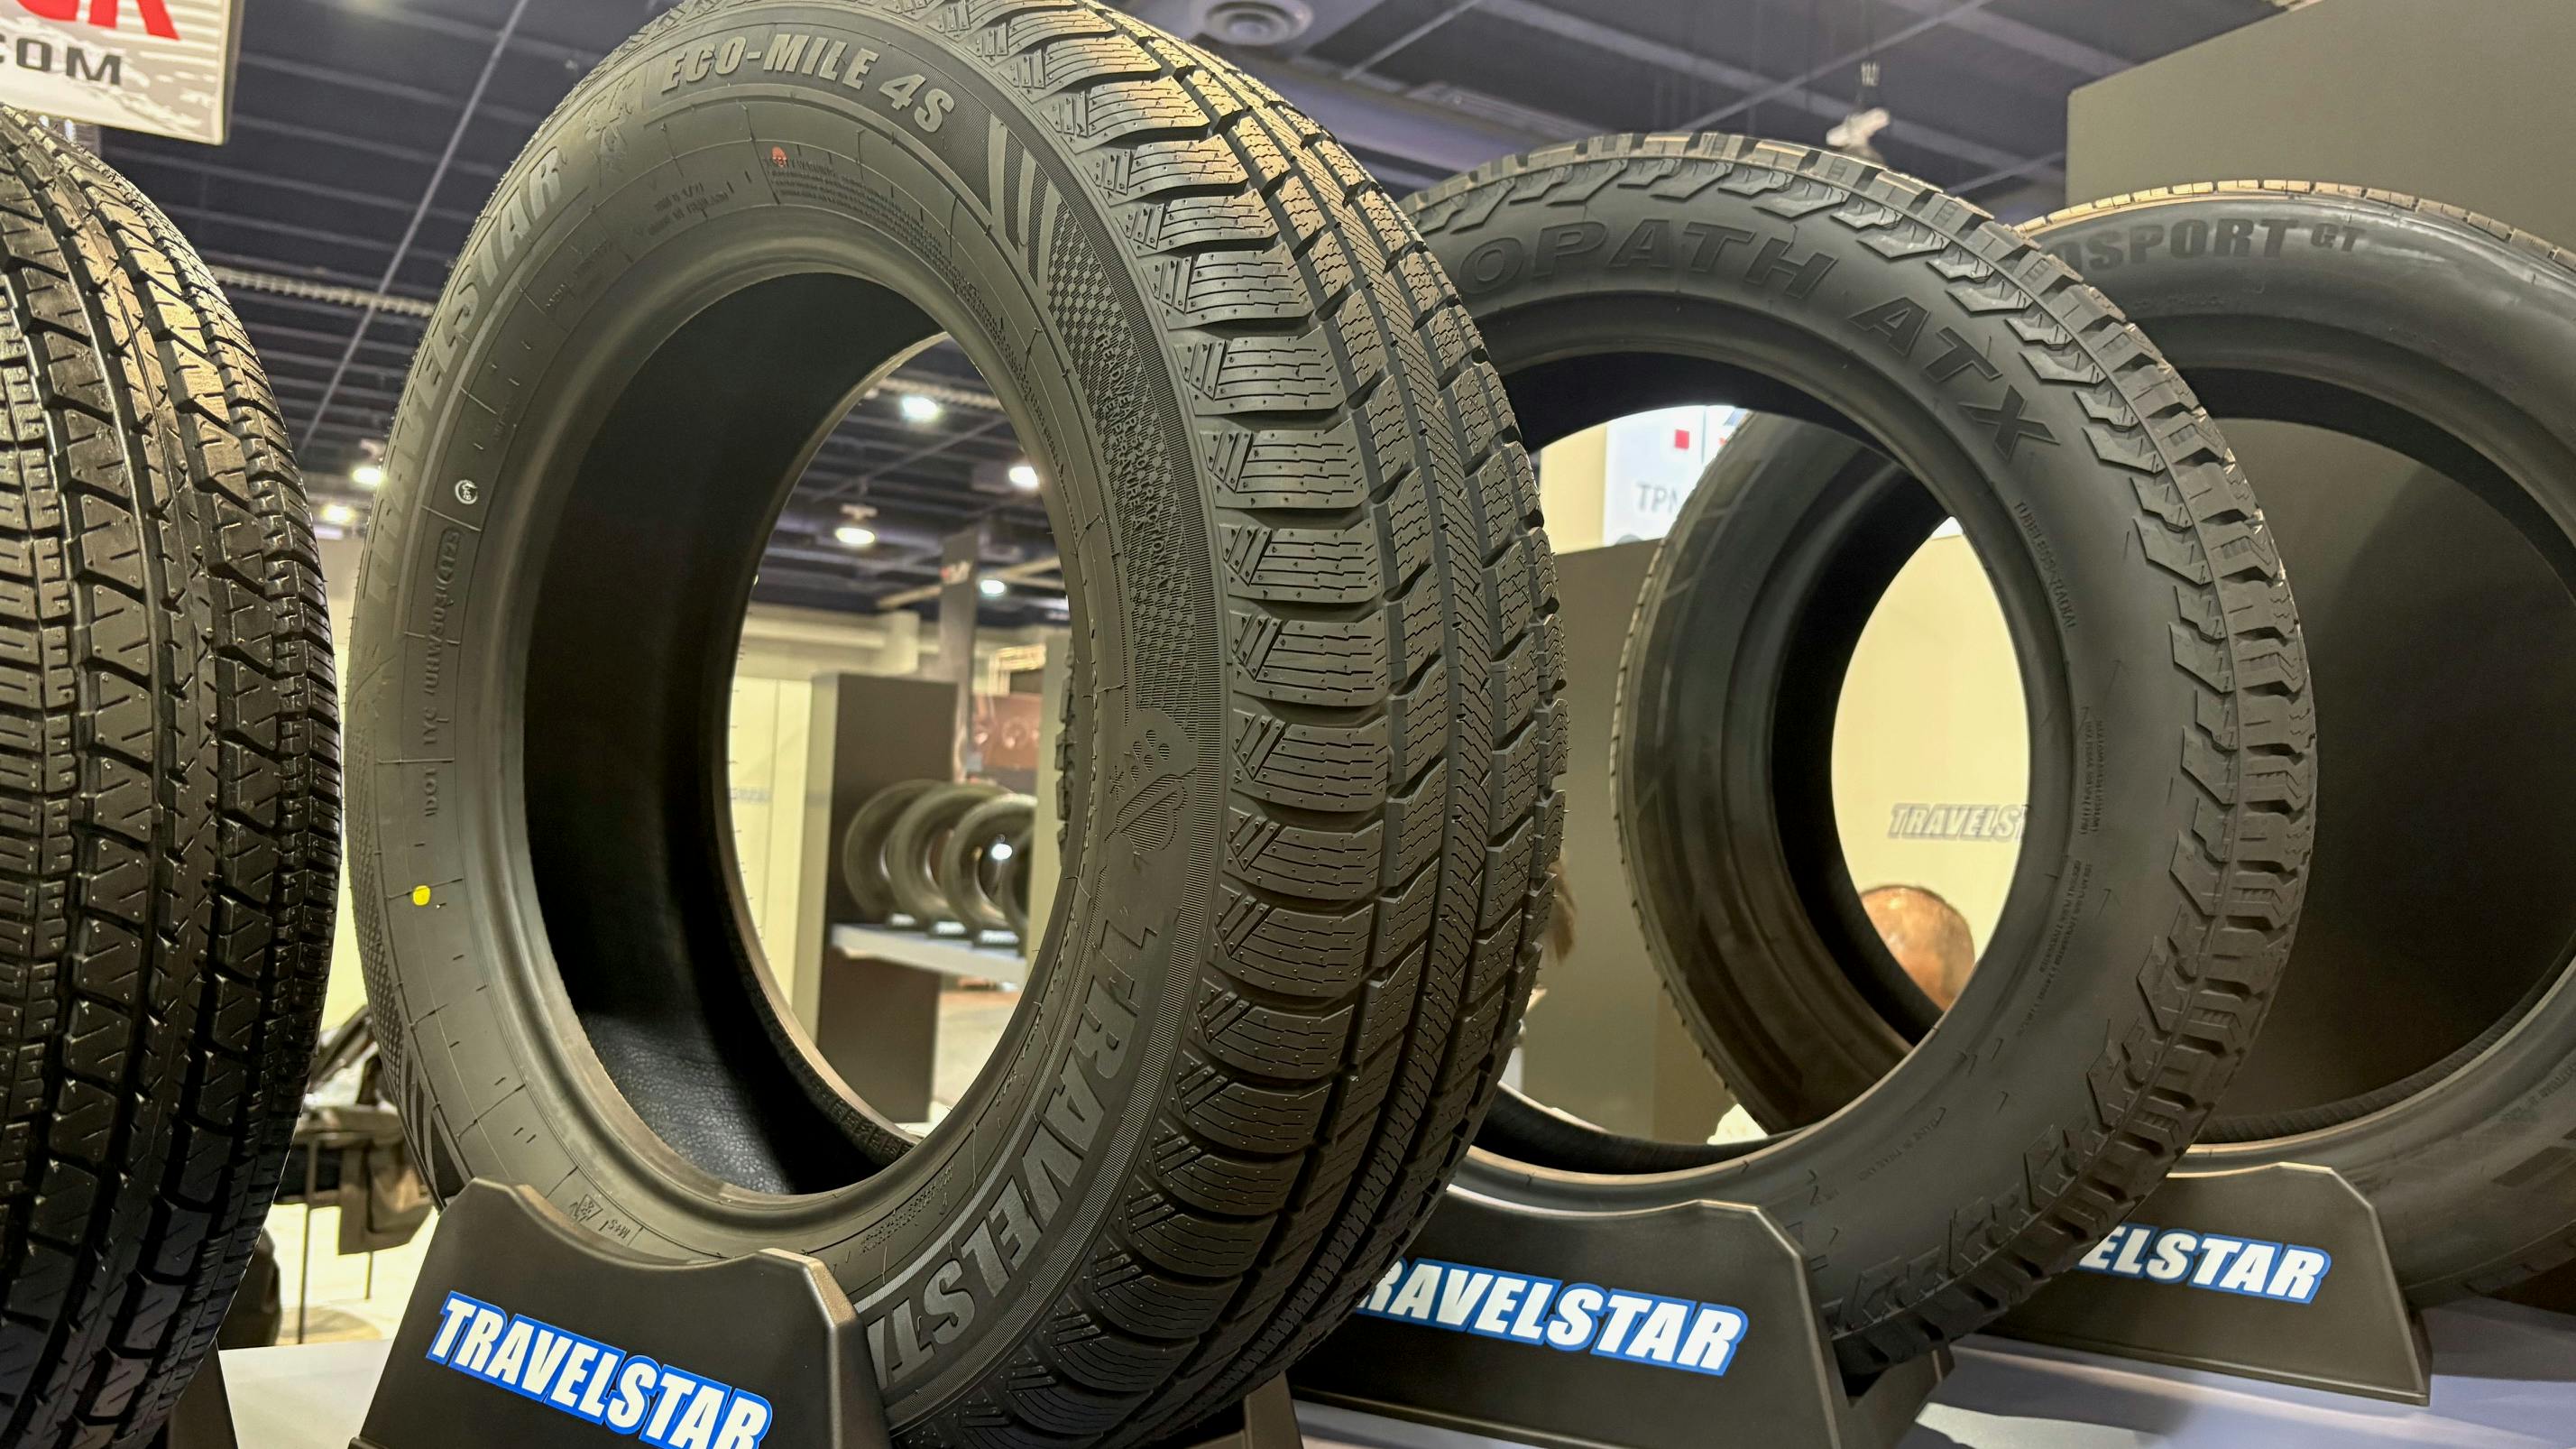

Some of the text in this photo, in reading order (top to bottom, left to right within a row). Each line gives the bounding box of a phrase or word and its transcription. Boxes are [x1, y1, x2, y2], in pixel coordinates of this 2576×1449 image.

[0, 33, 121, 85] OM
[661, 33, 954, 134] ECO-MILE 4S
[2310, 222, 2368, 254] GT
[1849, 296, 2062, 463] ATX
[1094, 330, 1139, 431] TREADWEAR
[1140, 479, 1168, 569] TRACTION
[1101, 394, 1141, 510] TEMPERATURE
[428, 1294, 773, 1449] TRAVELSTAR
